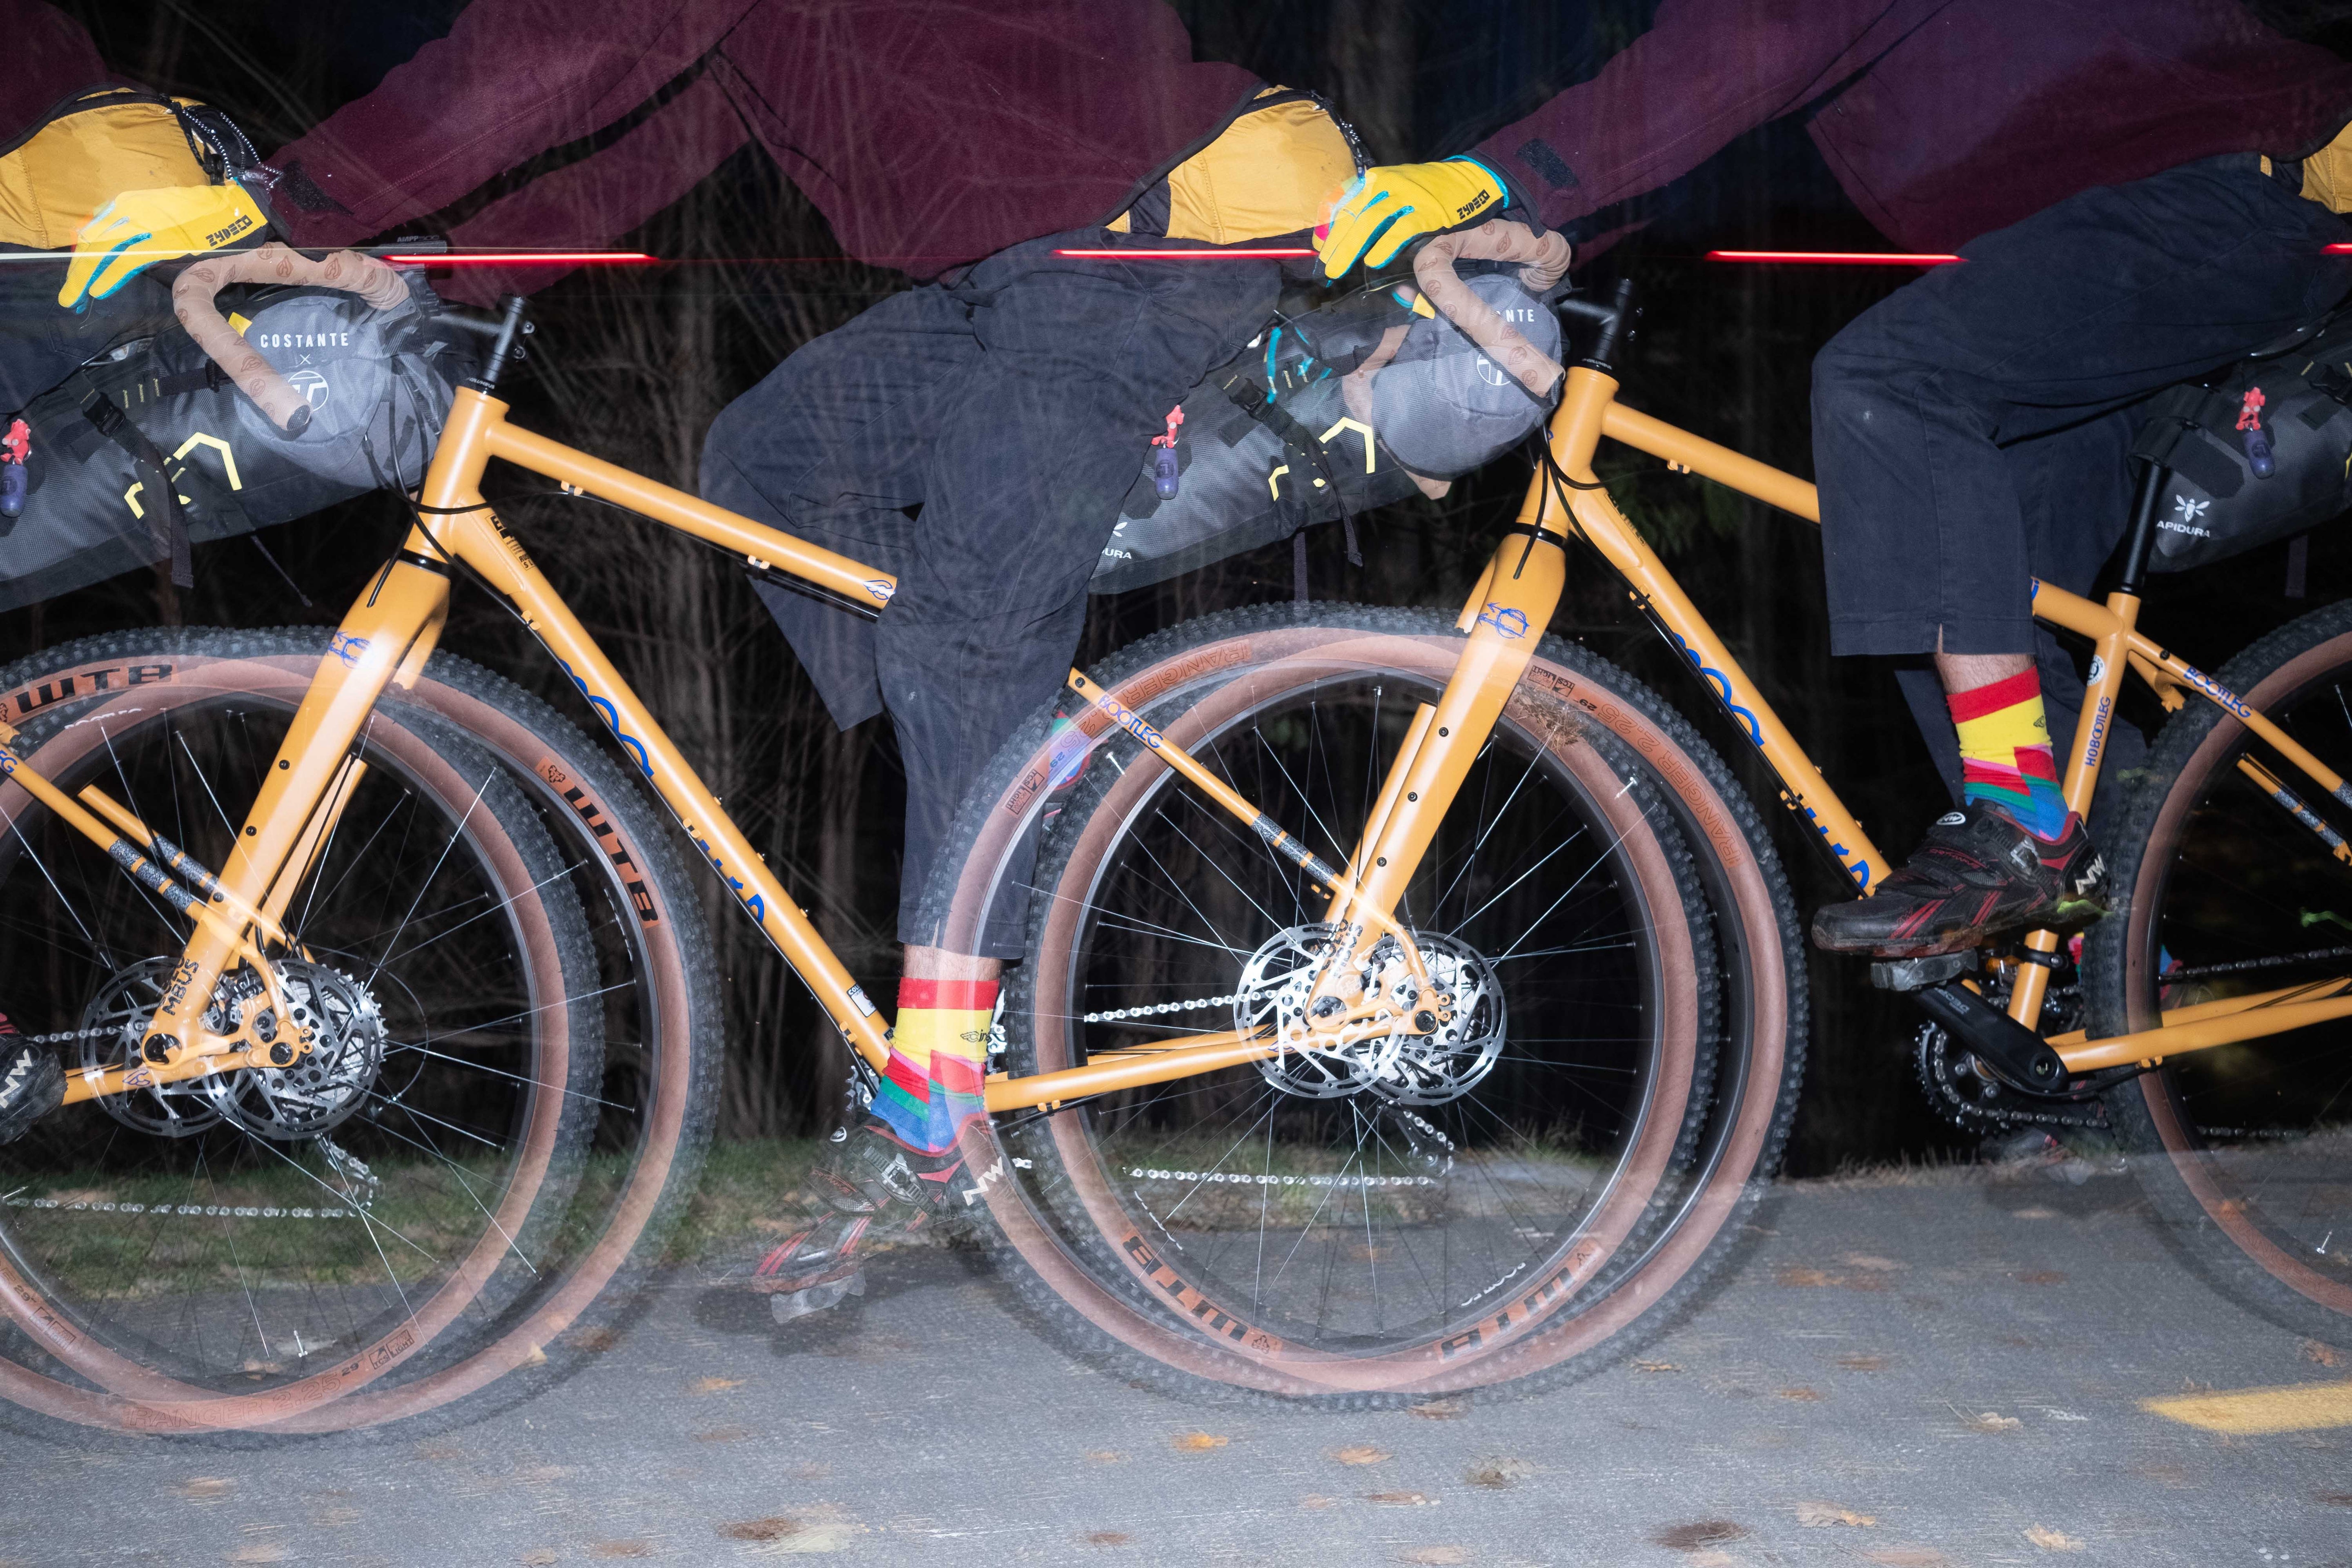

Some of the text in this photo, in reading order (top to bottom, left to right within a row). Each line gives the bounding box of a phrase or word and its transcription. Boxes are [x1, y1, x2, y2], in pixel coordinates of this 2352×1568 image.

[261, 333, 348, 347] COSTANTE
[2156, 520, 2210, 538] APIDURA
[15, 665, 172, 713] WTB
[1123, 642, 1245, 705] RANGER
[2183, 666, 2252, 718] BOOTLEG
[1098, 694, 1164, 748] BOOTLEG
[1597, 704, 1660, 753] 2.25
[1657, 751, 1742, 862] RANGER
[564, 785, 658, 922] WTB
[1123, 1236, 1249, 1341] WTB
[1441, 1267, 1576, 1361] WTB
[130, 1398, 265, 1427] RANGER
[273, 1372, 341, 1413] 2.25
